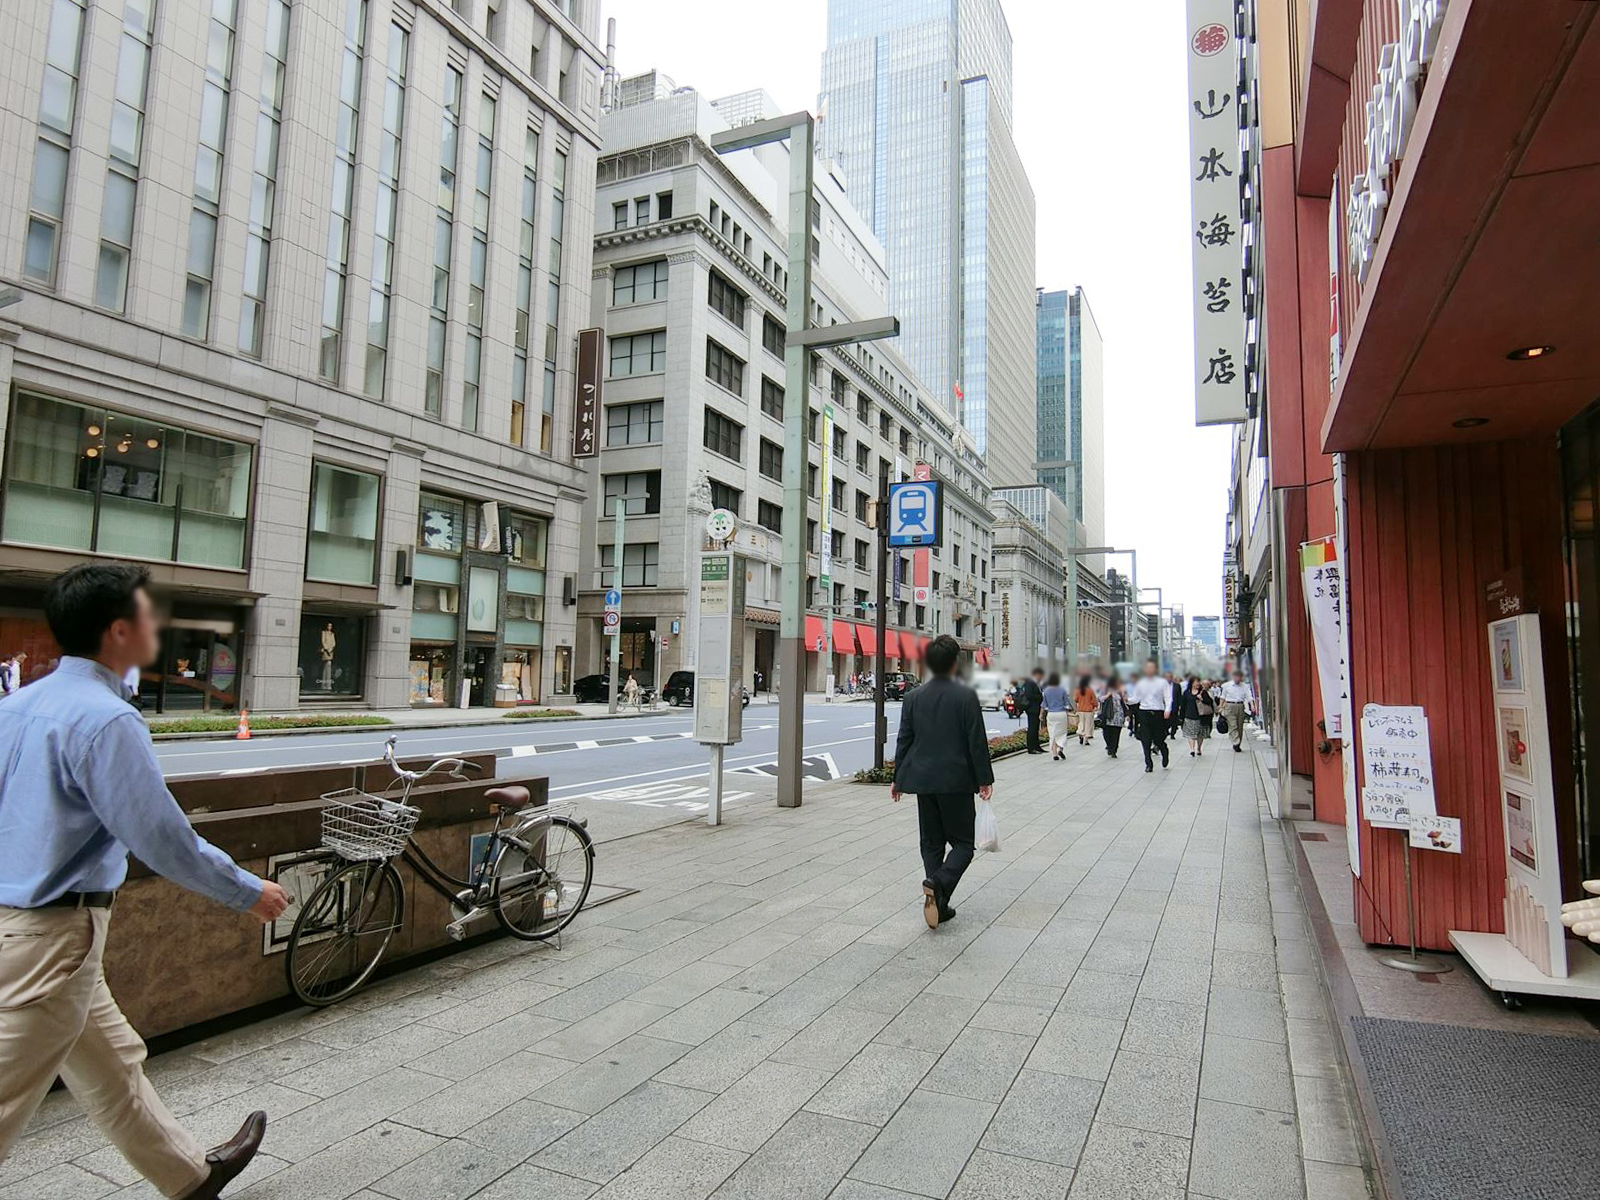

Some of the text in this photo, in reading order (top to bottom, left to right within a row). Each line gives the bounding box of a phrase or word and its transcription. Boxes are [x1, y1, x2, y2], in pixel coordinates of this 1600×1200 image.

[1194, 89, 1236, 385] 山本海苔店
